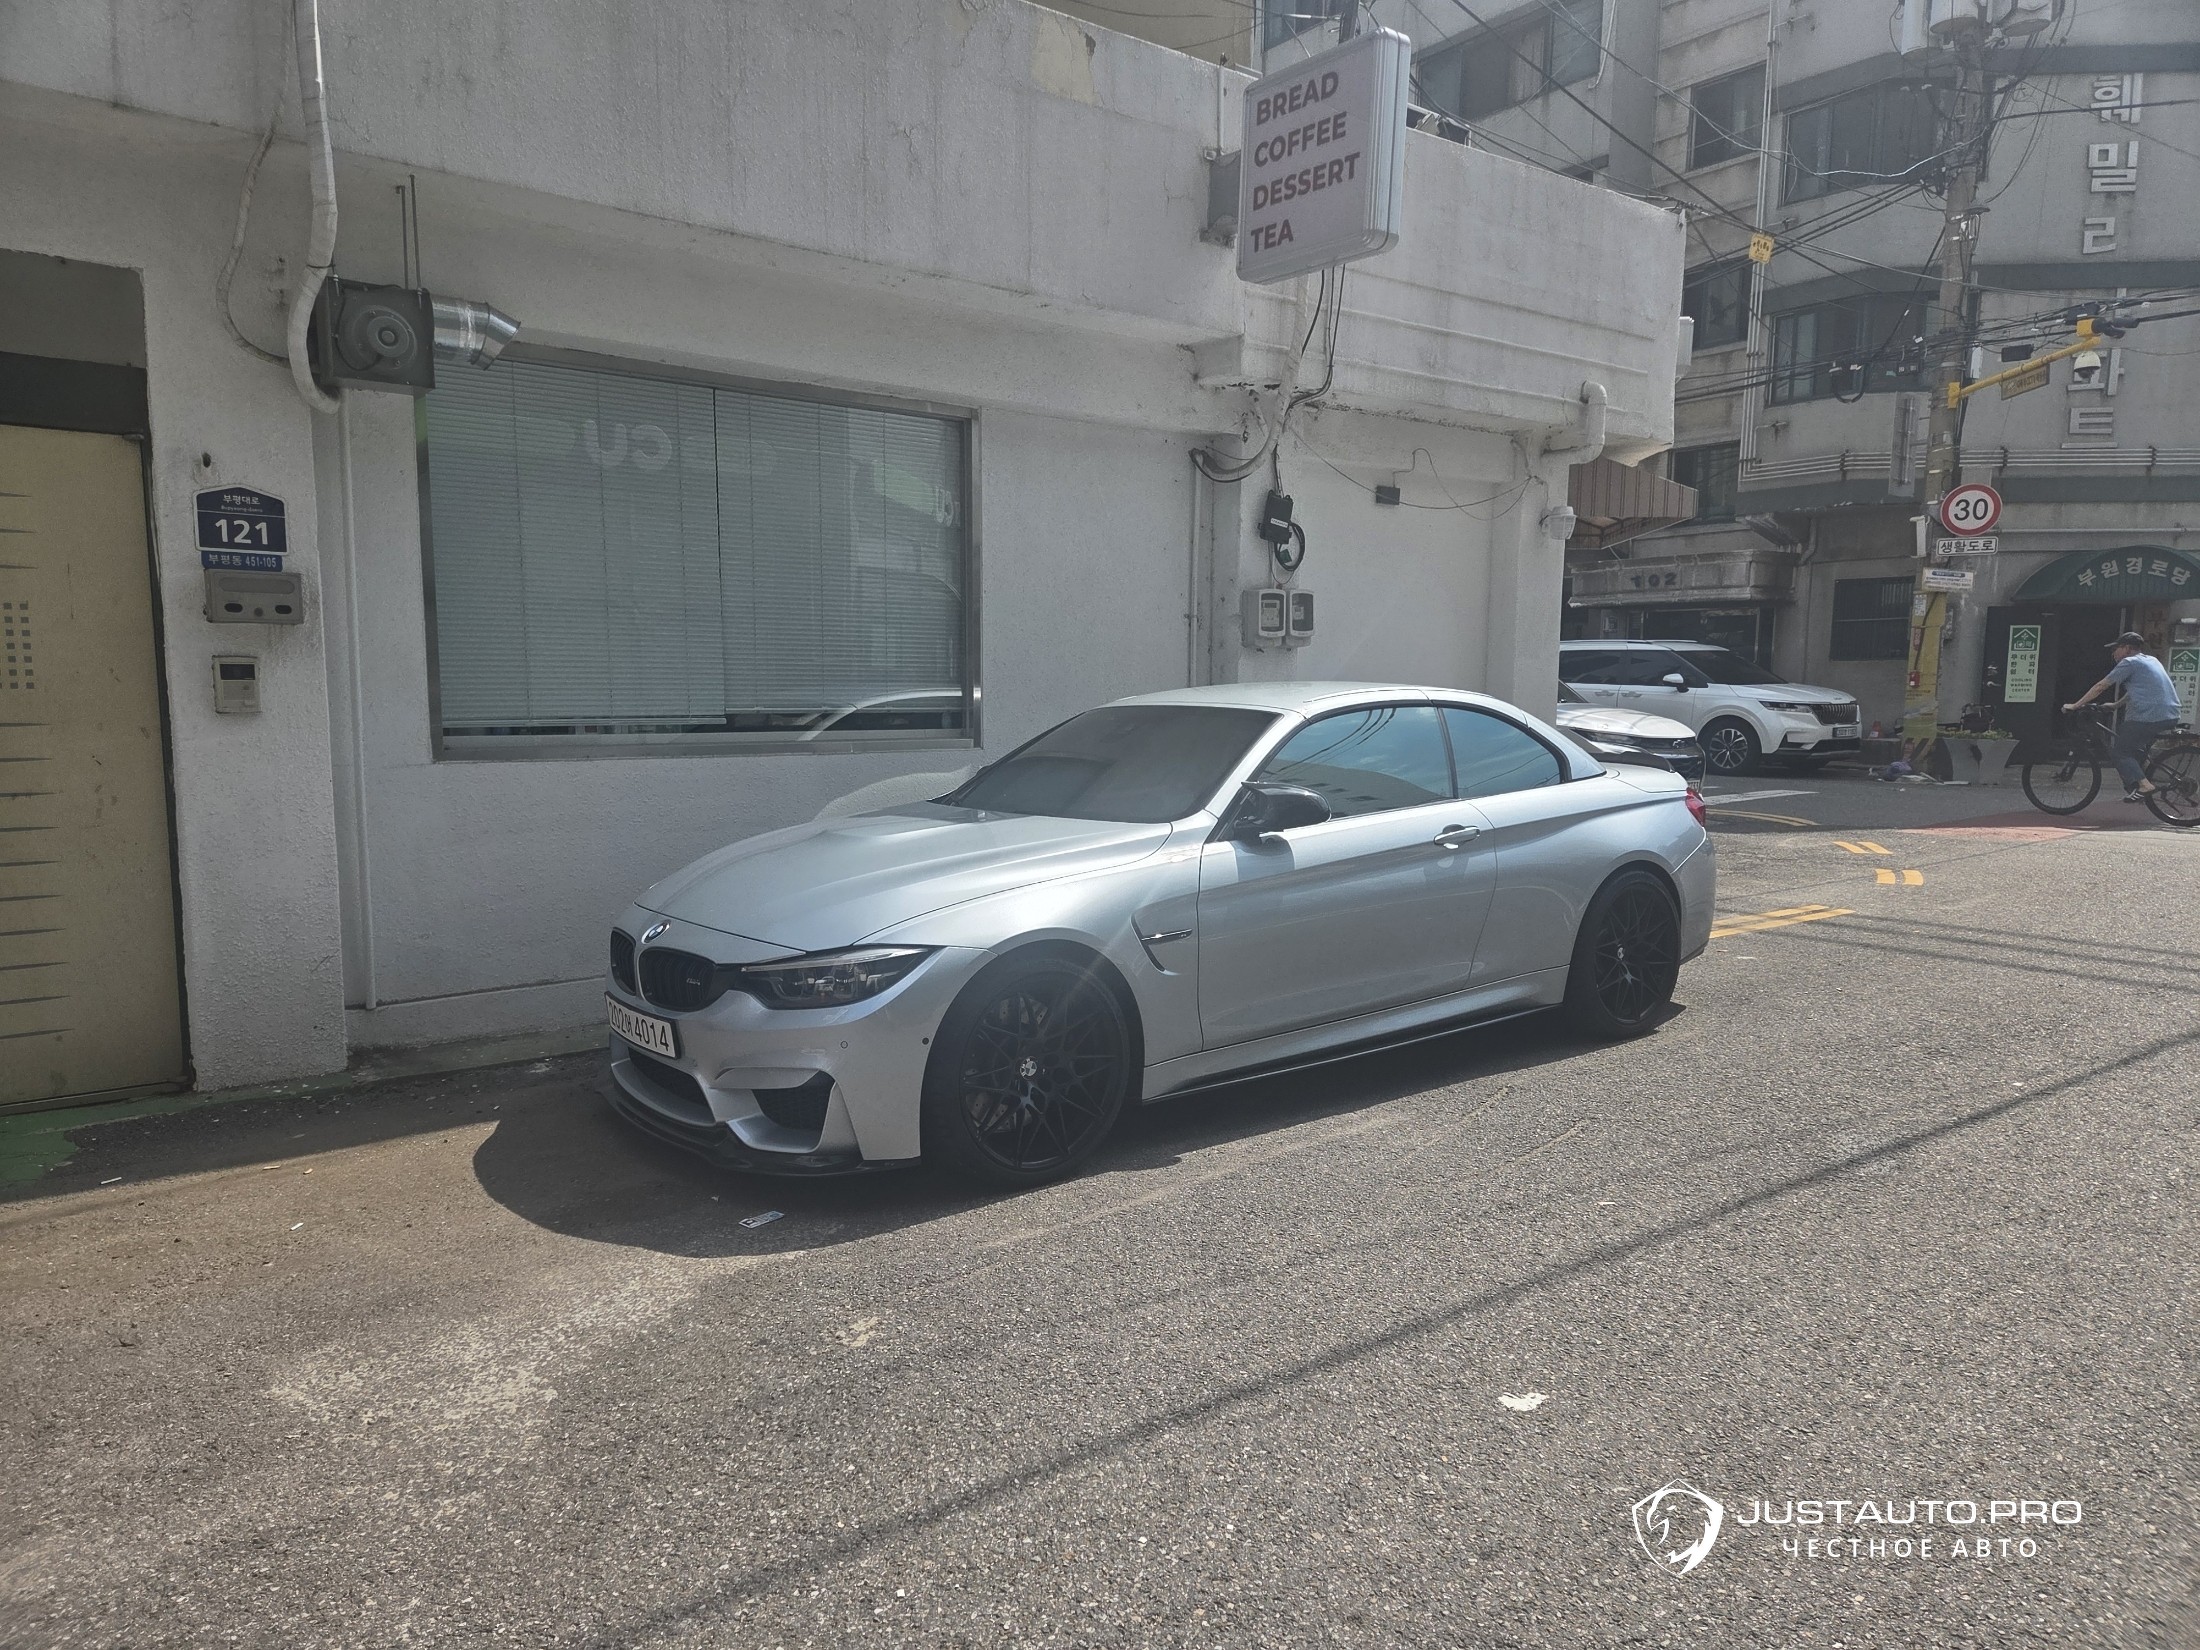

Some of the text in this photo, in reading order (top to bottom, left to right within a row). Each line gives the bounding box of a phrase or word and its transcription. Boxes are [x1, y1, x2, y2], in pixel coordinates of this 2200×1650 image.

[1256, 71, 1339, 126] BREAD
[1254, 111, 1348, 168] COFFEE
[1253, 152, 1361, 212] DESSERT
[1250, 219, 1294, 253] TEA
[223, 494, 261, 505] 부평대로
[1953, 498, 1989, 521] 30
[215, 518, 268, 545] 121
[208, 553, 277, 568] 부평동 451-105
[1940, 540, 1994, 553] 생활도로
[1630, 572, 1677, 588] 102
[2077, 556, 2191, 586] 부원경로당
[634, 1016, 670, 1052] 4014
